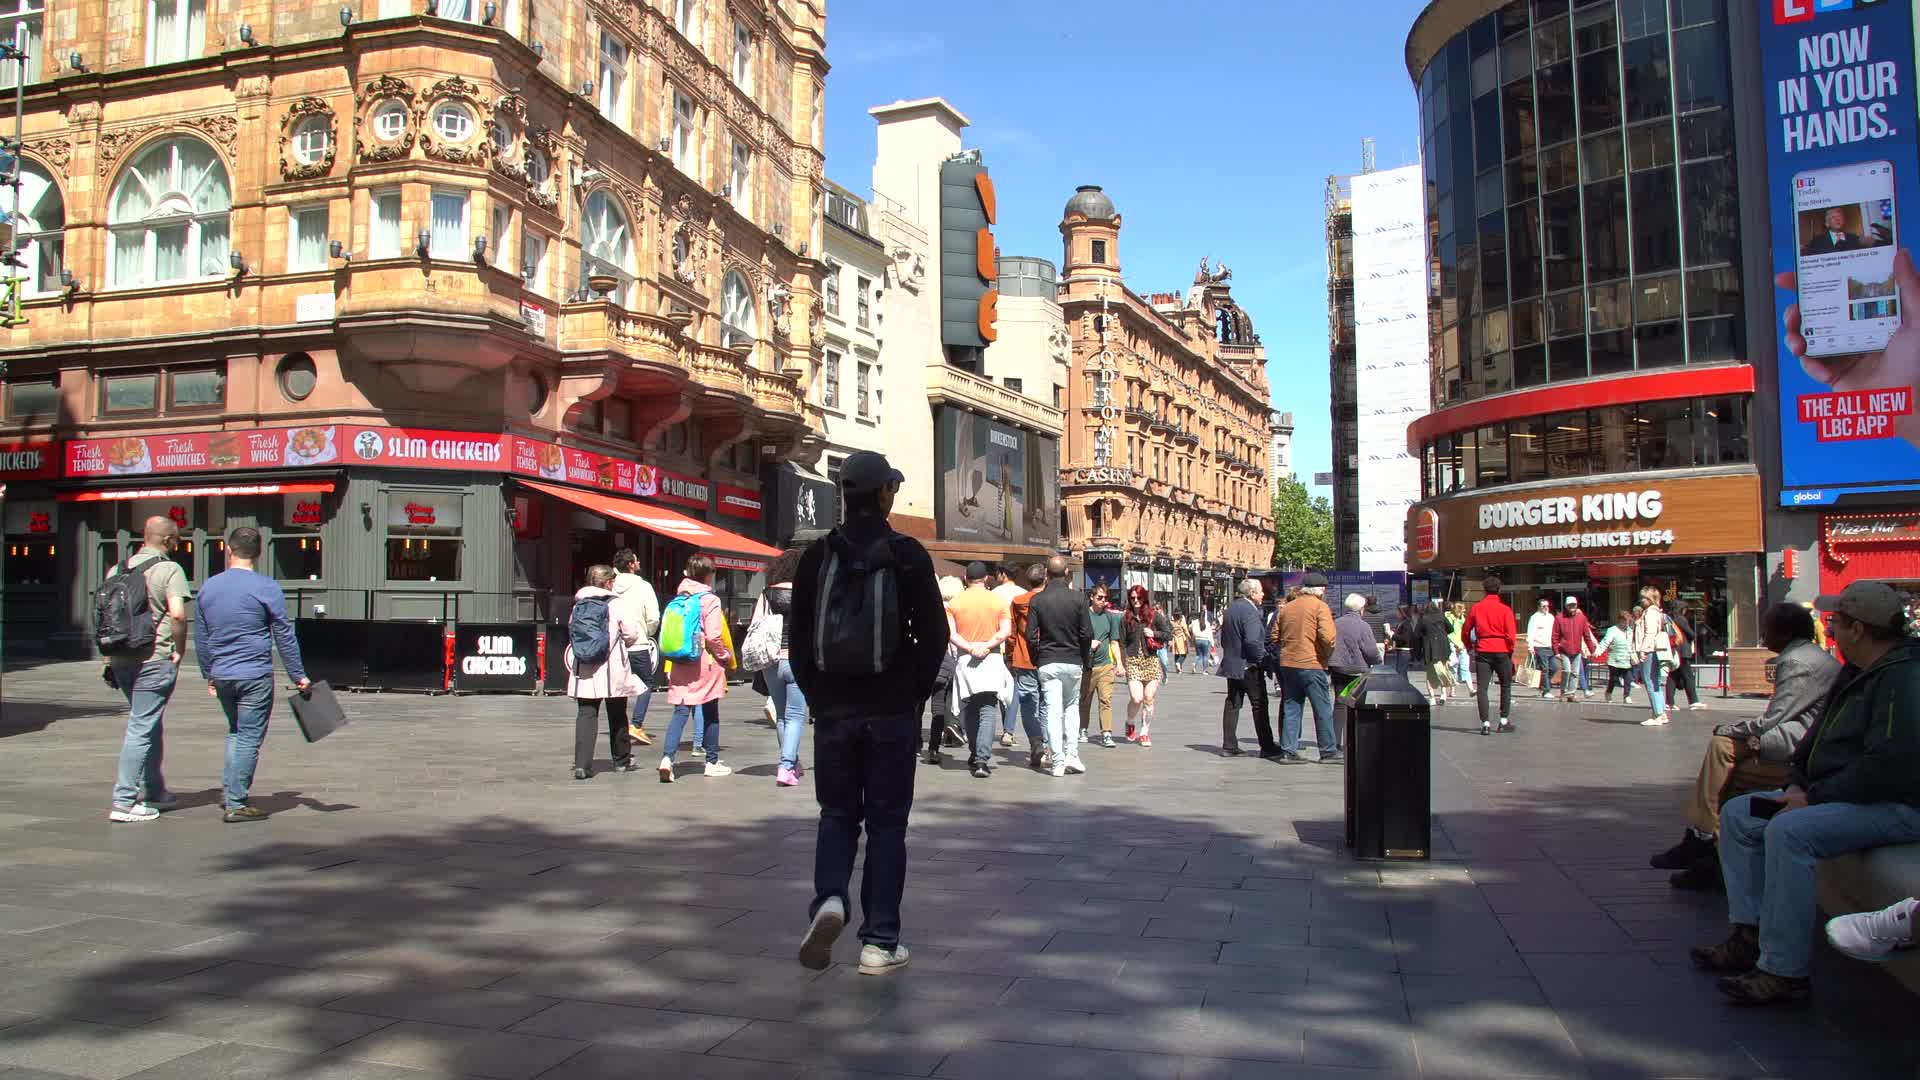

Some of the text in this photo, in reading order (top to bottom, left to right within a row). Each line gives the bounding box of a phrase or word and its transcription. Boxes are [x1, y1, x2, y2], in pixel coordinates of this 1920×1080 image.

[1799, 25, 1869, 73] NOW
[1778, 61, 1897, 115] IN YOUR
[1783, 102, 1896, 153] HANDS.
[1802, 392, 1905, 418] THE ALL NEW
[1822, 415, 1887, 438] LBC APP
[165, 438, 194, 453] Fresh
[248, 433, 279, 449] Fresh
[388, 437, 501, 463] SLIM CHICKENS
[73, 444, 101, 459] Fresh
[156, 452, 206, 467] SANDWICHES
[250, 449, 279, 463] WINGS
[72, 458, 105, 472] TENDERS
[671, 479, 685, 497] SLIM
[1792, 490, 1822, 504] global
[1479, 490, 1663, 530] BURGER KING
[1832, 520, 1902, 536] Pizza Hut
[1472, 529, 1675, 554] FLAME GRILLING SINCE 1954
[477, 635, 514, 655] SLIM
[462, 656, 527, 675] CHICKENS
